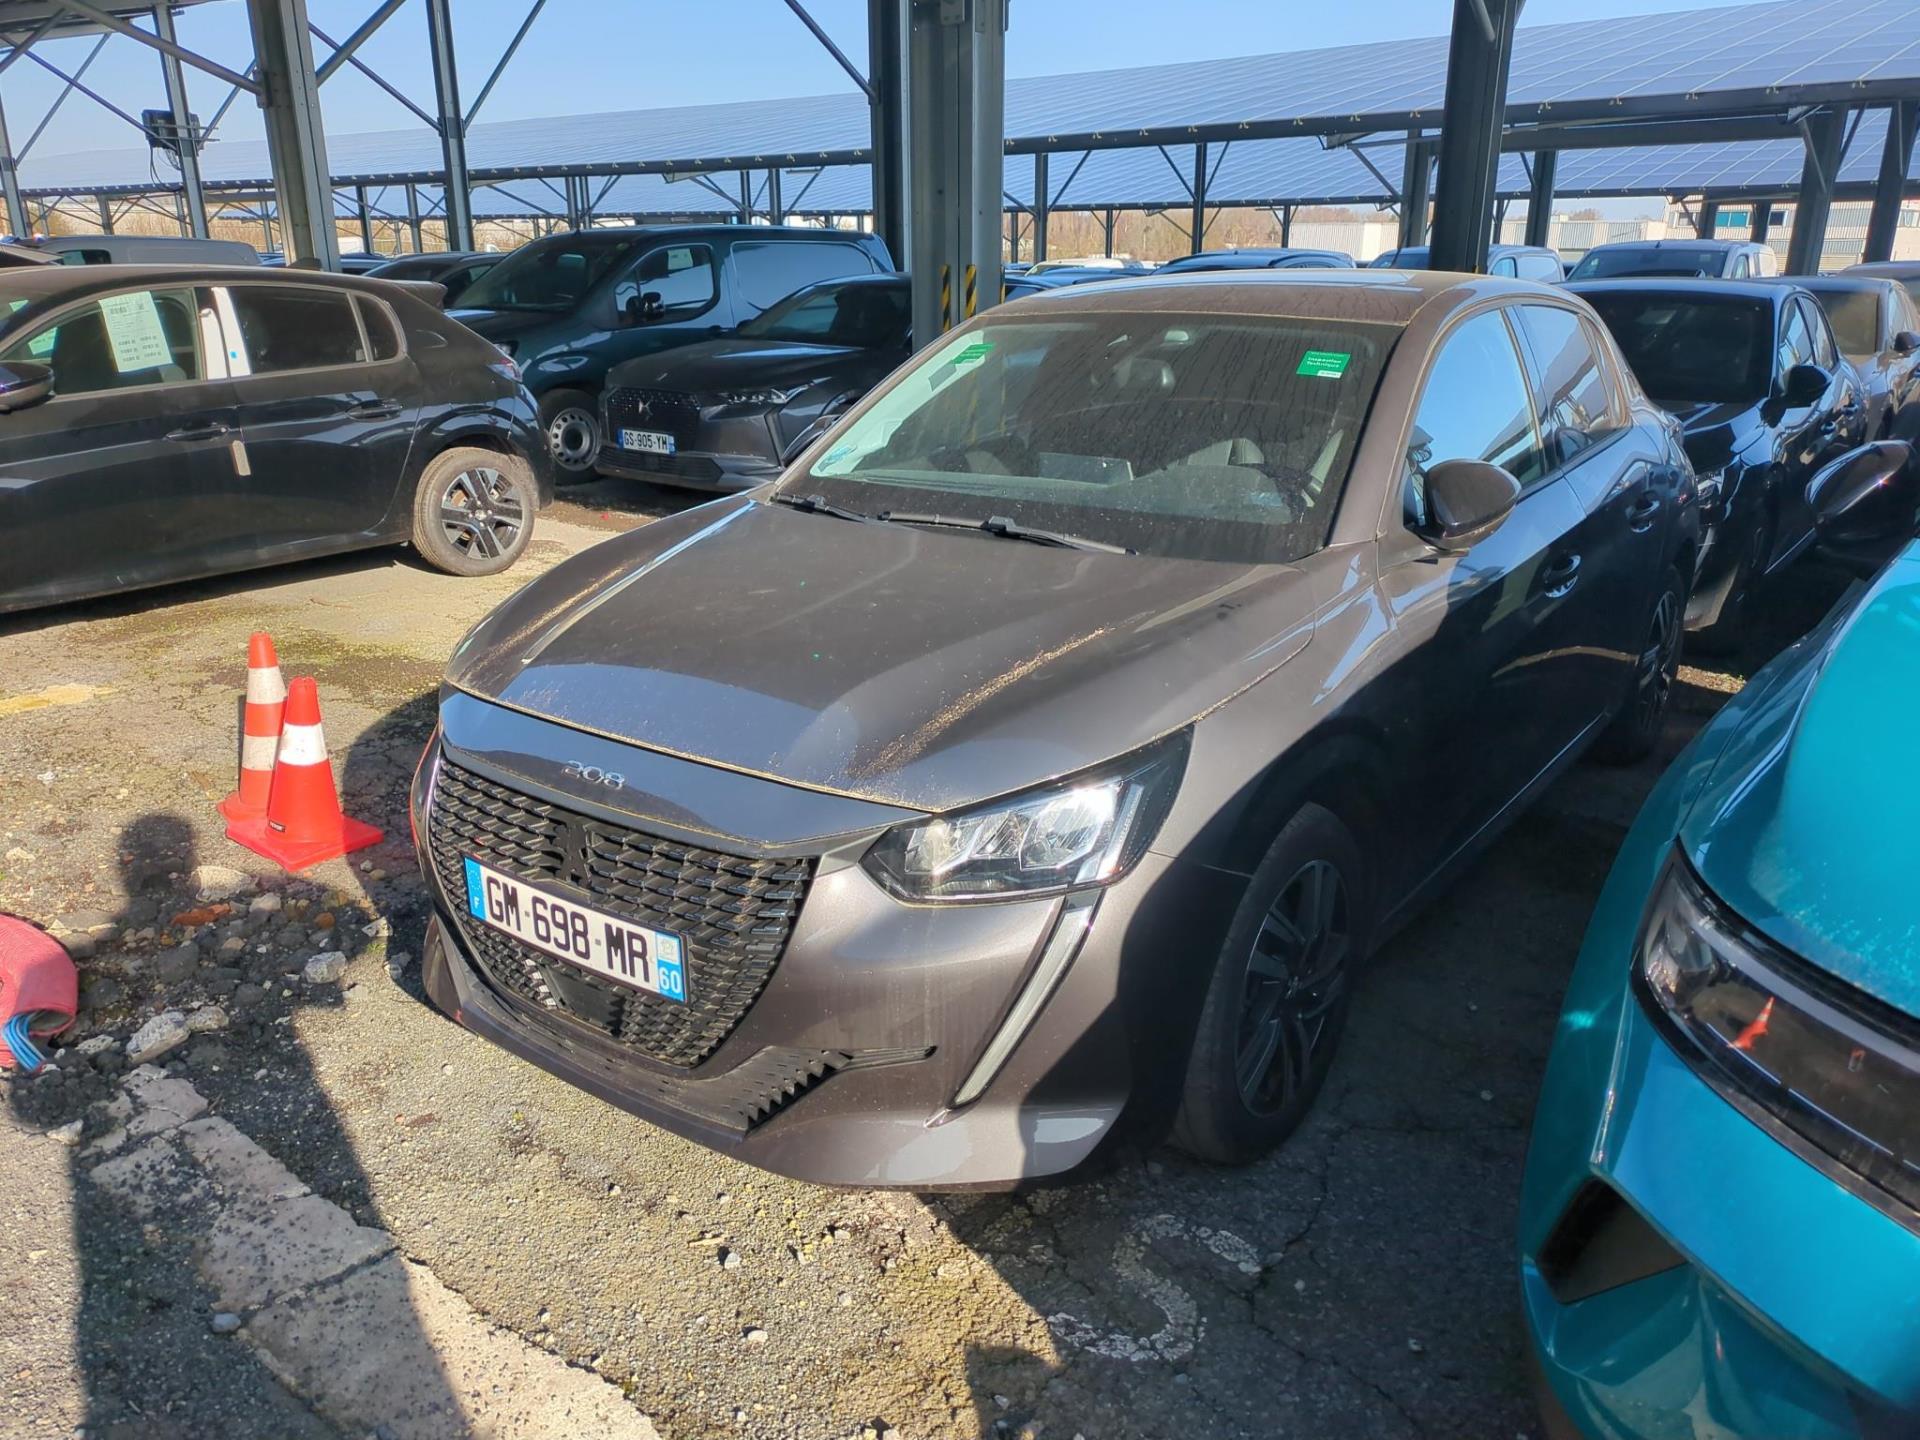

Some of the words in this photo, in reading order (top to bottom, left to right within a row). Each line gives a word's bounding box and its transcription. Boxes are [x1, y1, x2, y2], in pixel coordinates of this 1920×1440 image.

[561, 760, 625, 790] 208
[473, 895, 480, 909] F
[486, 875, 650, 983] GM-698-MR
[659, 967, 682, 994] 60
